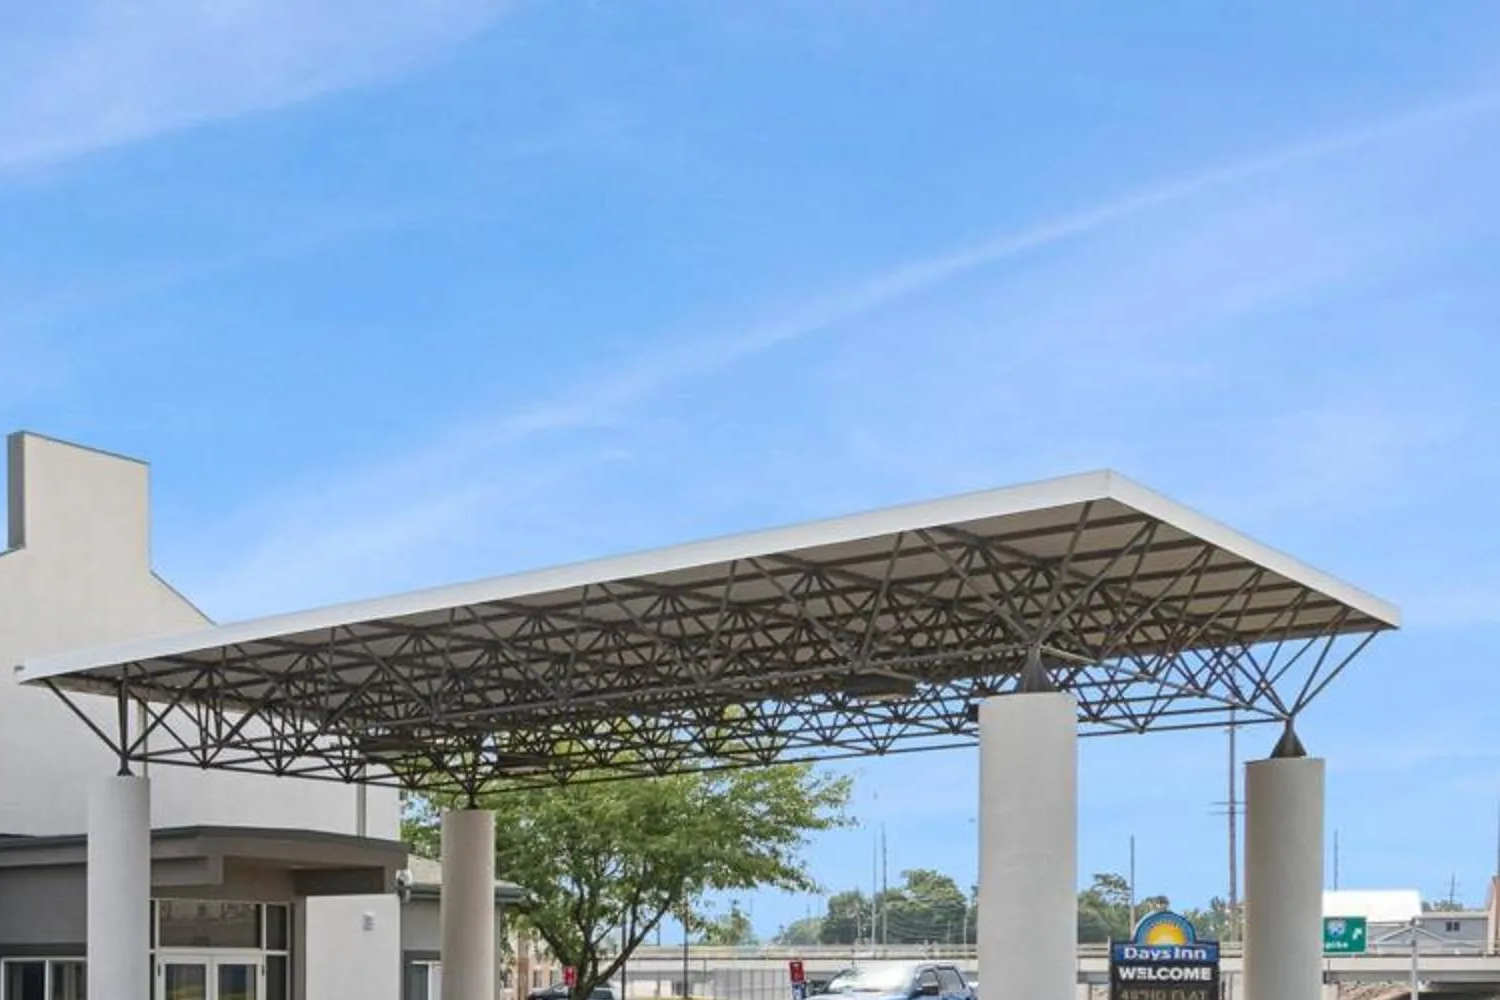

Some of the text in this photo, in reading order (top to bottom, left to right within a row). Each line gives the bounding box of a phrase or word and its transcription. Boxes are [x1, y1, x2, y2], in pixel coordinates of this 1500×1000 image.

[1124, 947, 1207, 961] Days Inn
[1119, 967, 1212, 981] WELCOME
